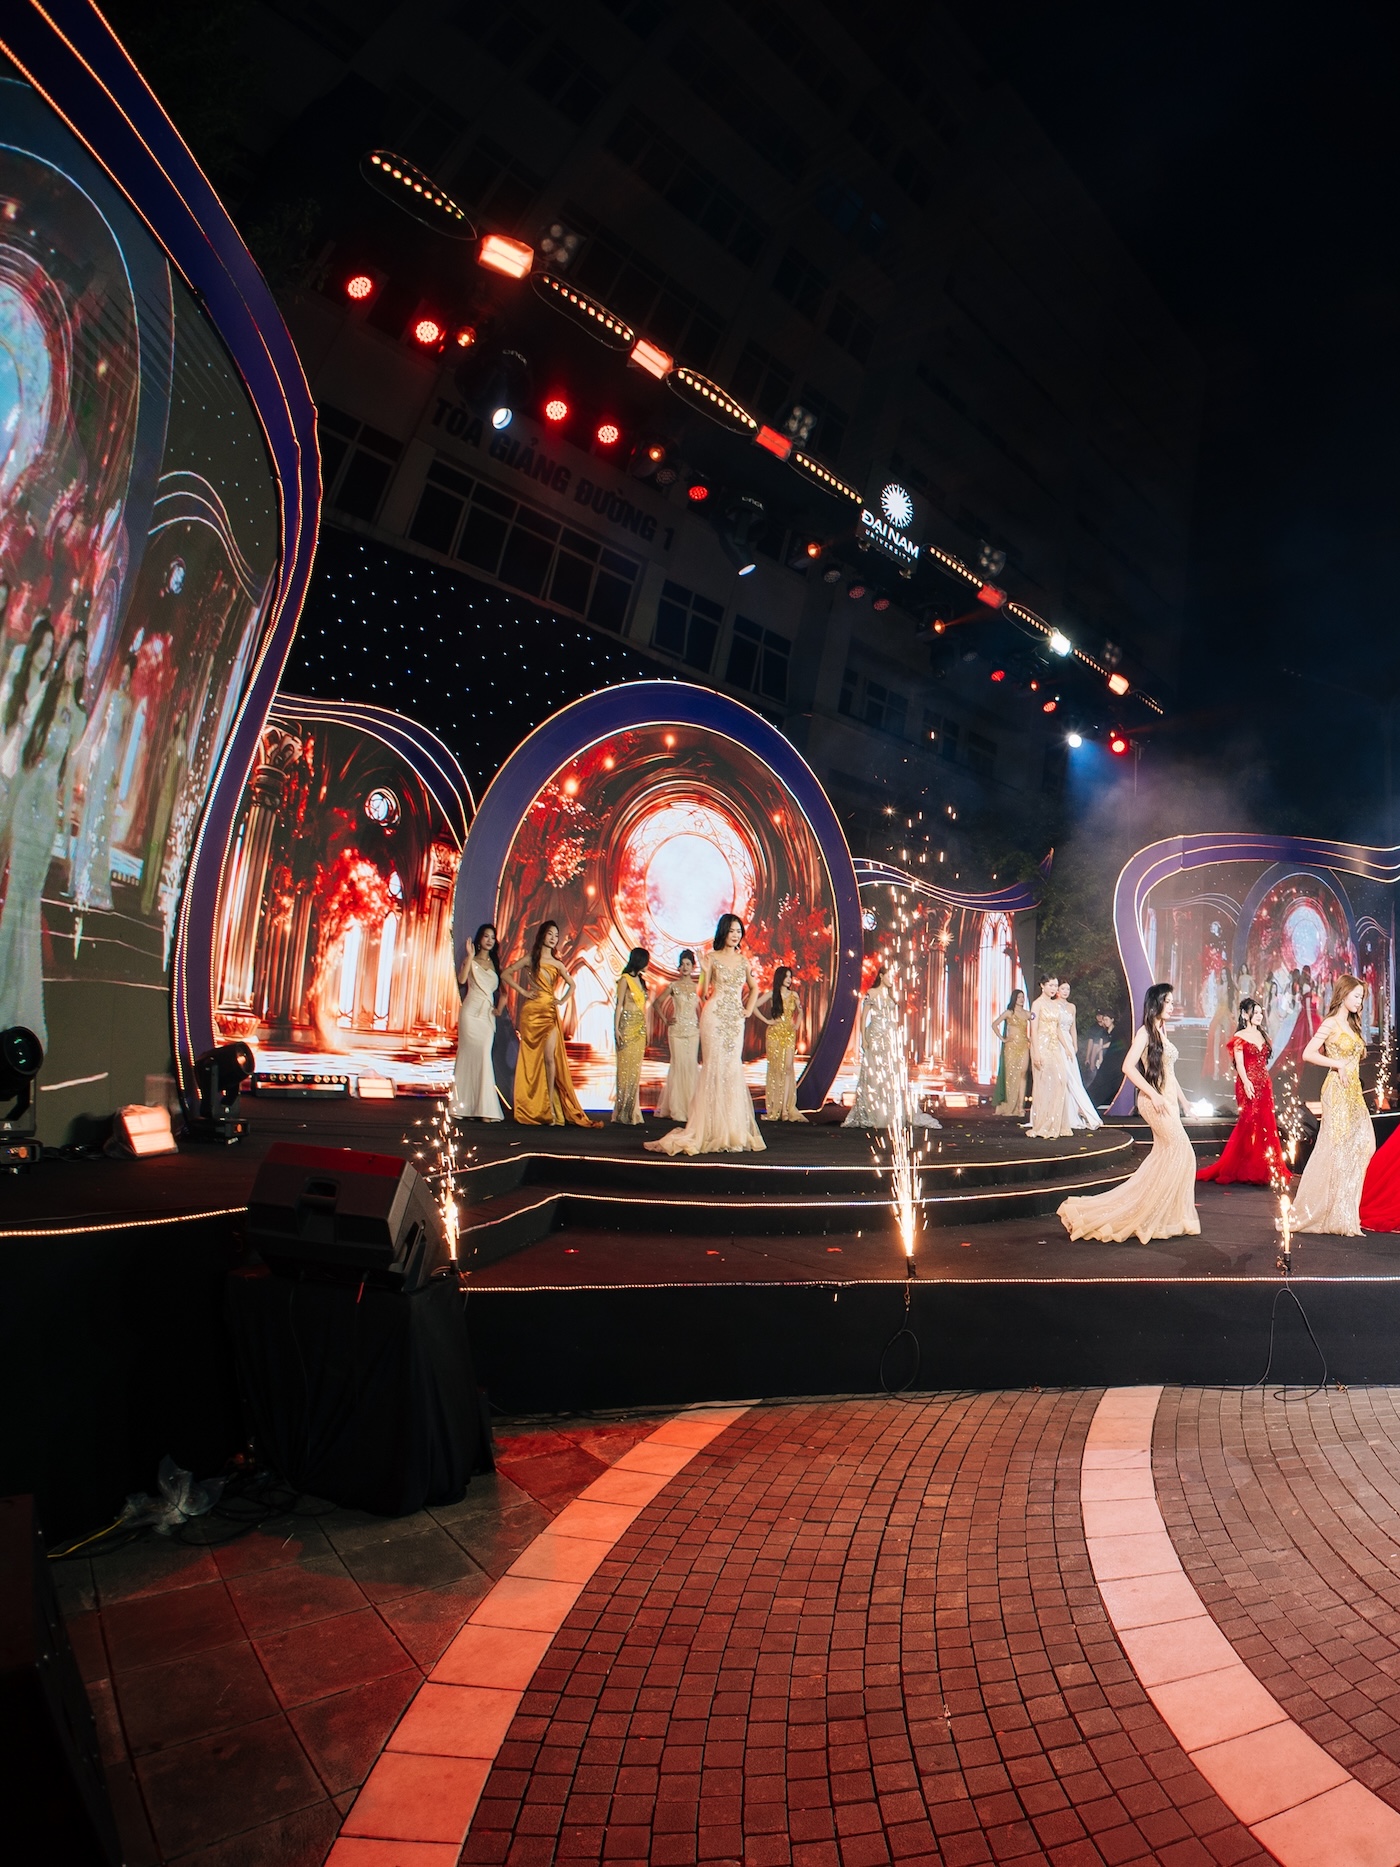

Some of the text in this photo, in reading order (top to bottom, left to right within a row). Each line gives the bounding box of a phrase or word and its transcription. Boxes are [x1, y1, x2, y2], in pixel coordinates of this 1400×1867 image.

[431, 397, 675, 551] TÒA GIẢNG ĐƯỜNG 1
[864, 529, 911, 563] UNIVERSITY
[888, 527, 920, 559] NAM
